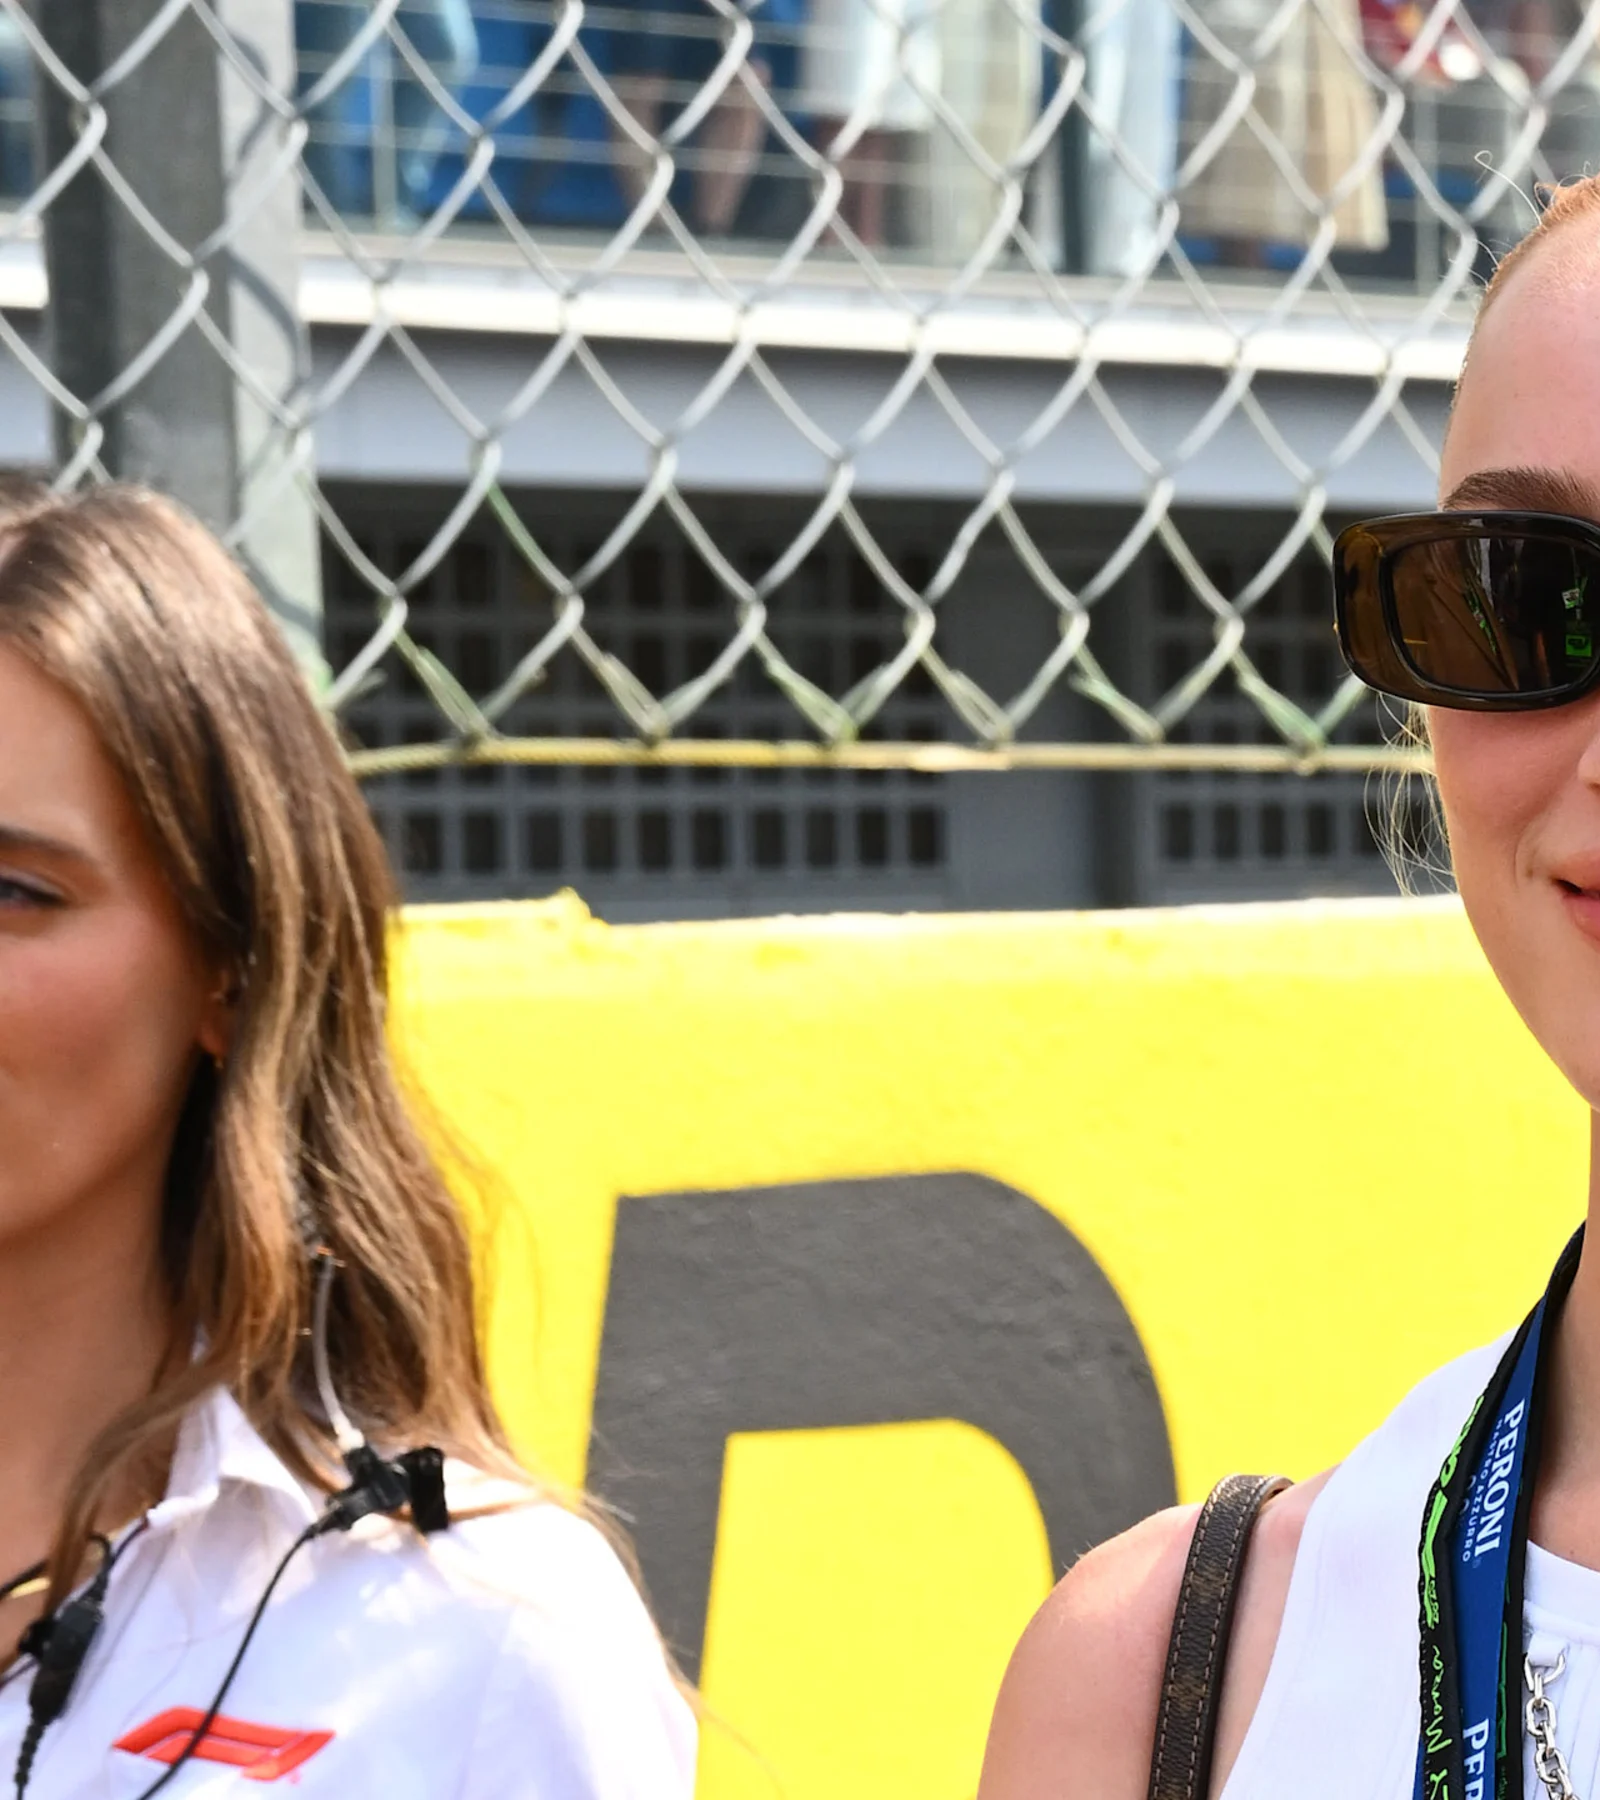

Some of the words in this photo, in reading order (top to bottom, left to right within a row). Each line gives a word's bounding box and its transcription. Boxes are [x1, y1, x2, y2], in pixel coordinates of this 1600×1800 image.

[1475, 1398, 1526, 1557] PERONI
[1481, 1419, 1503, 1480] NASTRO
[1462, 1483, 1484, 1562] AZZURRO
[1426, 1645, 1453, 1753] Monza
